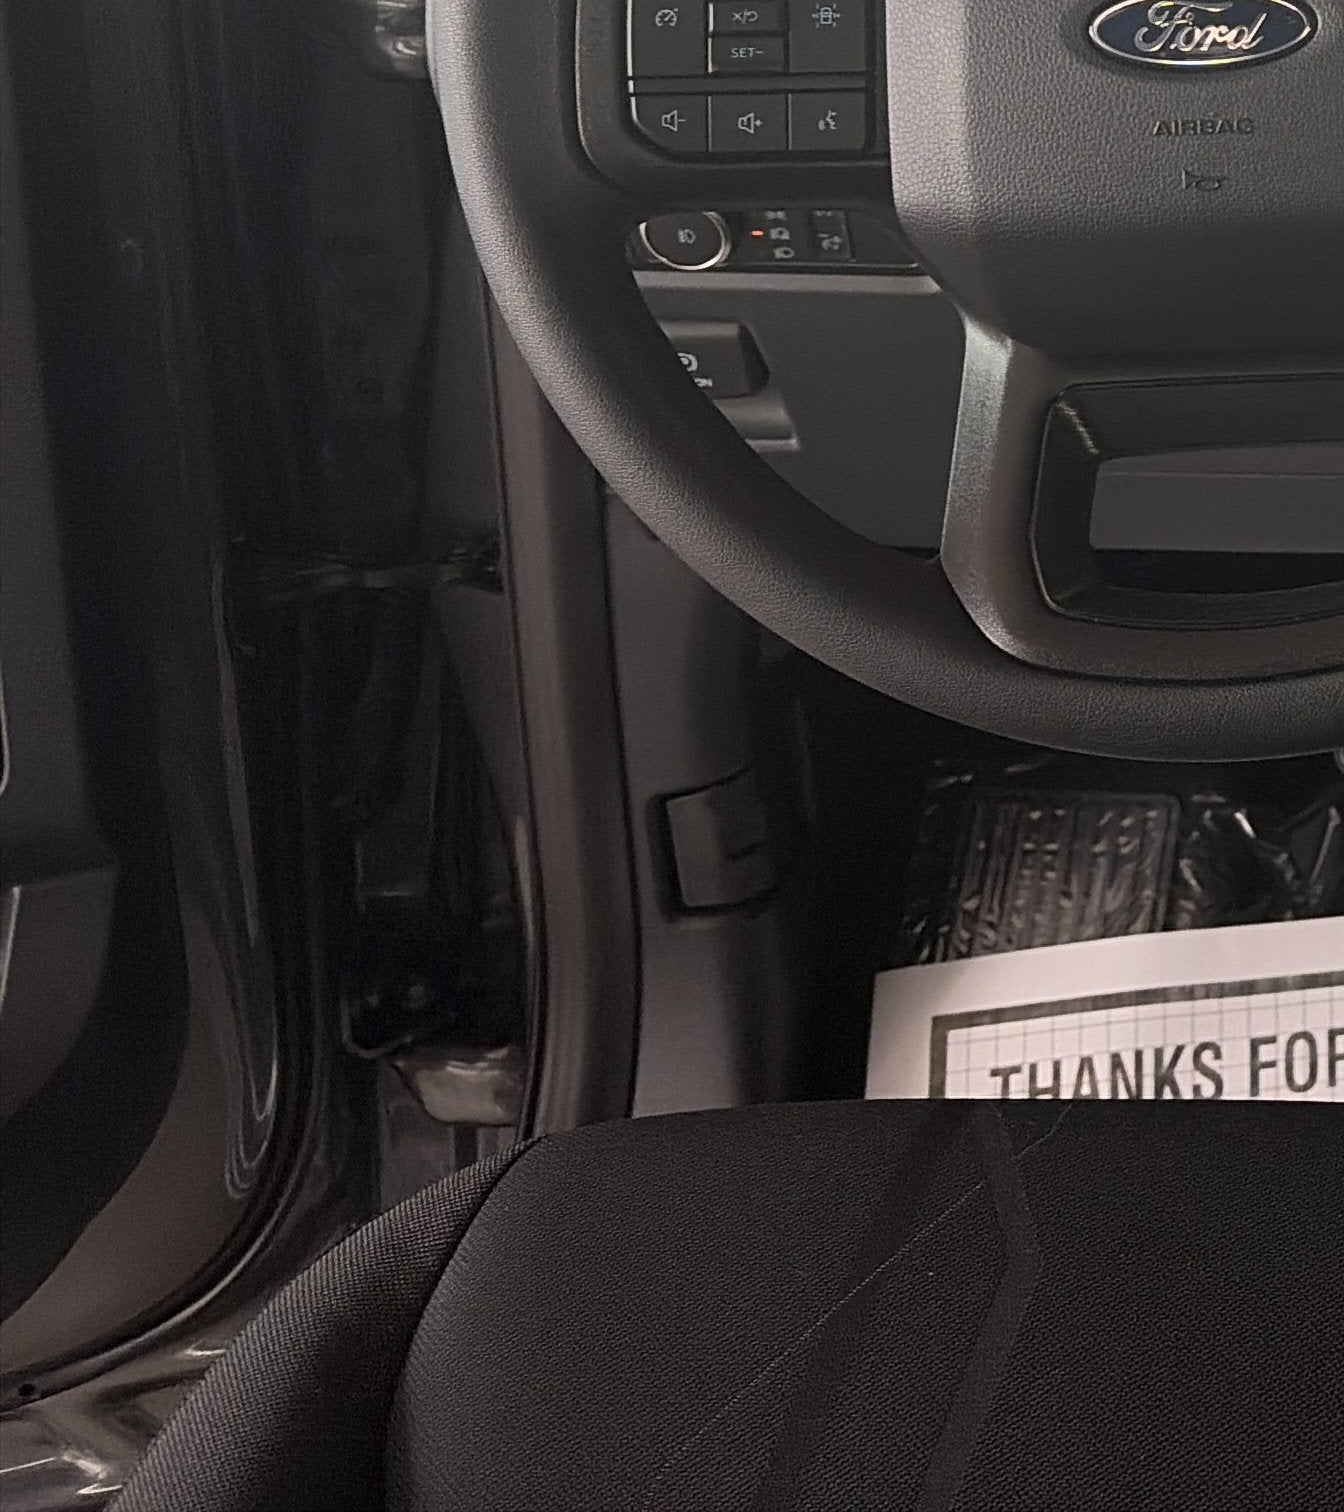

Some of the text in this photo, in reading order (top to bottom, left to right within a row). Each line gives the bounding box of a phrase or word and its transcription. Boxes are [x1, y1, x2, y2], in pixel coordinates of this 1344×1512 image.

[1134, 0, 1268, 53] Ford
[1152, 117, 1255, 138] AIRBAG
[989, 1040, 1224, 1100] THANKS
